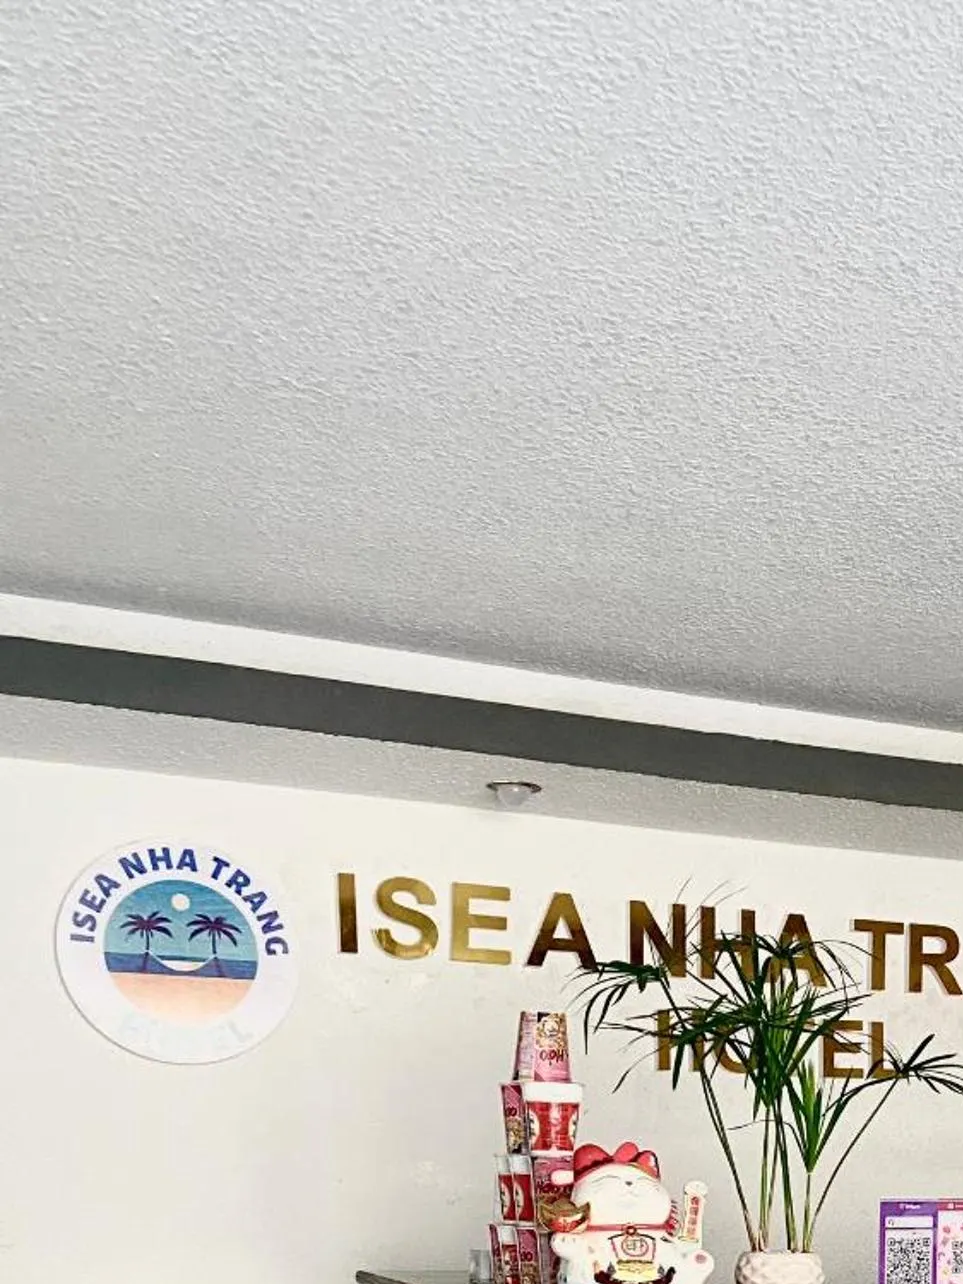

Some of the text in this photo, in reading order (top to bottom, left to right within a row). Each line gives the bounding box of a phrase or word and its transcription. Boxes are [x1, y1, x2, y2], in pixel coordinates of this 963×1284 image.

[70, 847, 289, 956] ISEA NHA TRANG
[336, 872, 598, 973] ISEA
[628, 900, 828, 987] NHA
